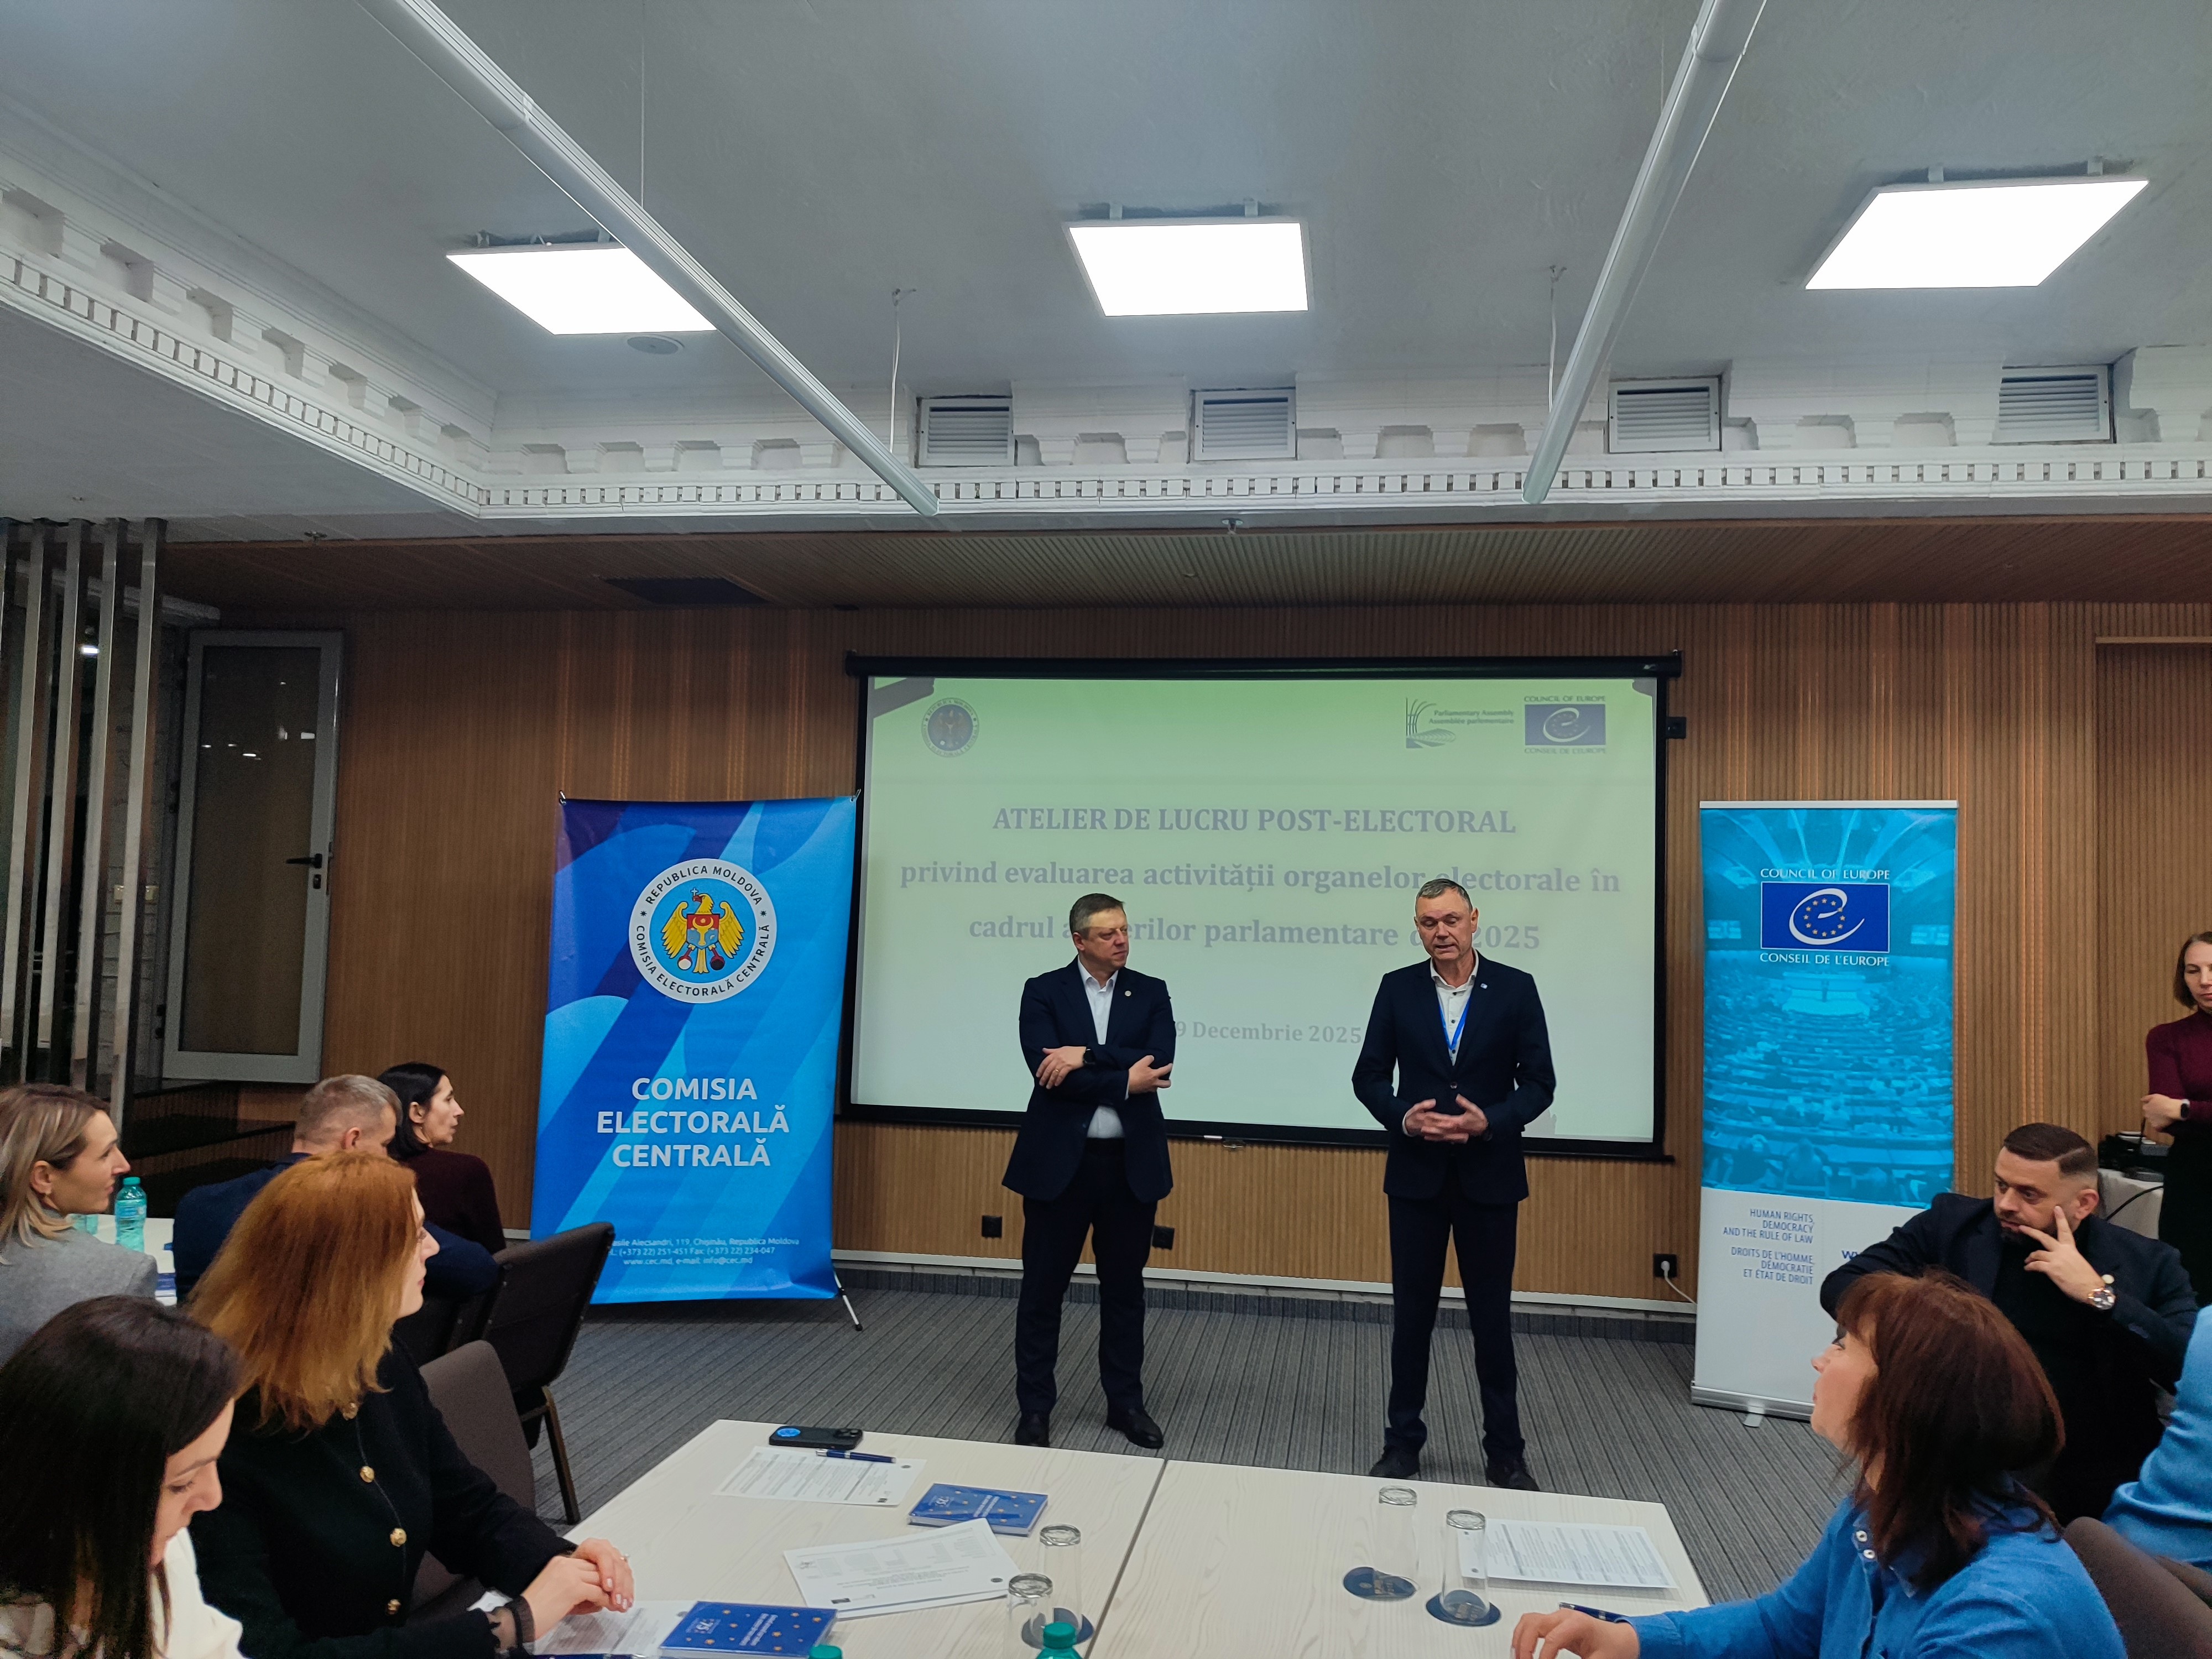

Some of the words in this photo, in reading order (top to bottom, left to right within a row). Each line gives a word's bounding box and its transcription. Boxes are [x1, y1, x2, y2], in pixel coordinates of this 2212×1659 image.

[993, 808, 1108, 830] ATELIER
[1114, 808, 1150, 830] DE
[1159, 808, 1249, 831] LUCRU
[1258, 809, 1516, 833] POST-ELECTORAL
[645, 866, 708, 904] REPUBLICA
[712, 866, 763, 905] MOLDOVA
[900, 861, 997, 888] privind
[1004, 862, 1135, 884] evaluarea
[1143, 863, 1274, 893] activității
[1284, 865, 1426, 894] organelor
[1590, 868, 1620, 892] în
[1760, 868, 1819, 879] COUNCIL
[1821, 869, 1837, 879] OF
[1843, 869, 1890, 880] EUROPE
[969, 915, 1053, 938] cadrul
[1204, 919, 1398, 948] parlamentare
[1472, 925, 1540, 950] 2025
[637, 925, 657, 974] COMISIA
[656, 973, 735, 997] ELECTORALĂ
[736, 925, 770, 983] CENTRALĂ
[1760, 952, 1811, 964] CONSEIL
[1815, 954, 1830, 964] DE
[1835, 954, 1890, 967] L'EUROPE
[1193, 1021, 1303, 1042] Decembrie
[1308, 1026, 1361, 1044] 2025
[632, 1078, 758, 1101] COMISIA
[597, 1104, 790, 1134] ELECTORALĂ
[612, 1138, 771, 1167] CENTRALĂ
[1750, 1208, 1781, 1219] HUMAN
[1723, 1227, 1740, 1236] AND
[1742, 1228, 1757, 1238] THE
[1759, 1230, 1780, 1240] RULE
[1782, 1232, 1792, 1241] OF
[1794, 1234, 1814, 1244] LAW
[1762, 1220, 1814, 1233] DEMOCRACY
[1731, 1246, 1760, 1258] DROITS
[1762, 1250, 1772, 1259] DE
[1743, 1269, 1752, 1278] ET
[1776, 1271, 1786, 1281] DE
[1788, 1274, 1813, 1285] DROIT
[1761, 1260, 1814, 1275] DÉMOCRATIE
